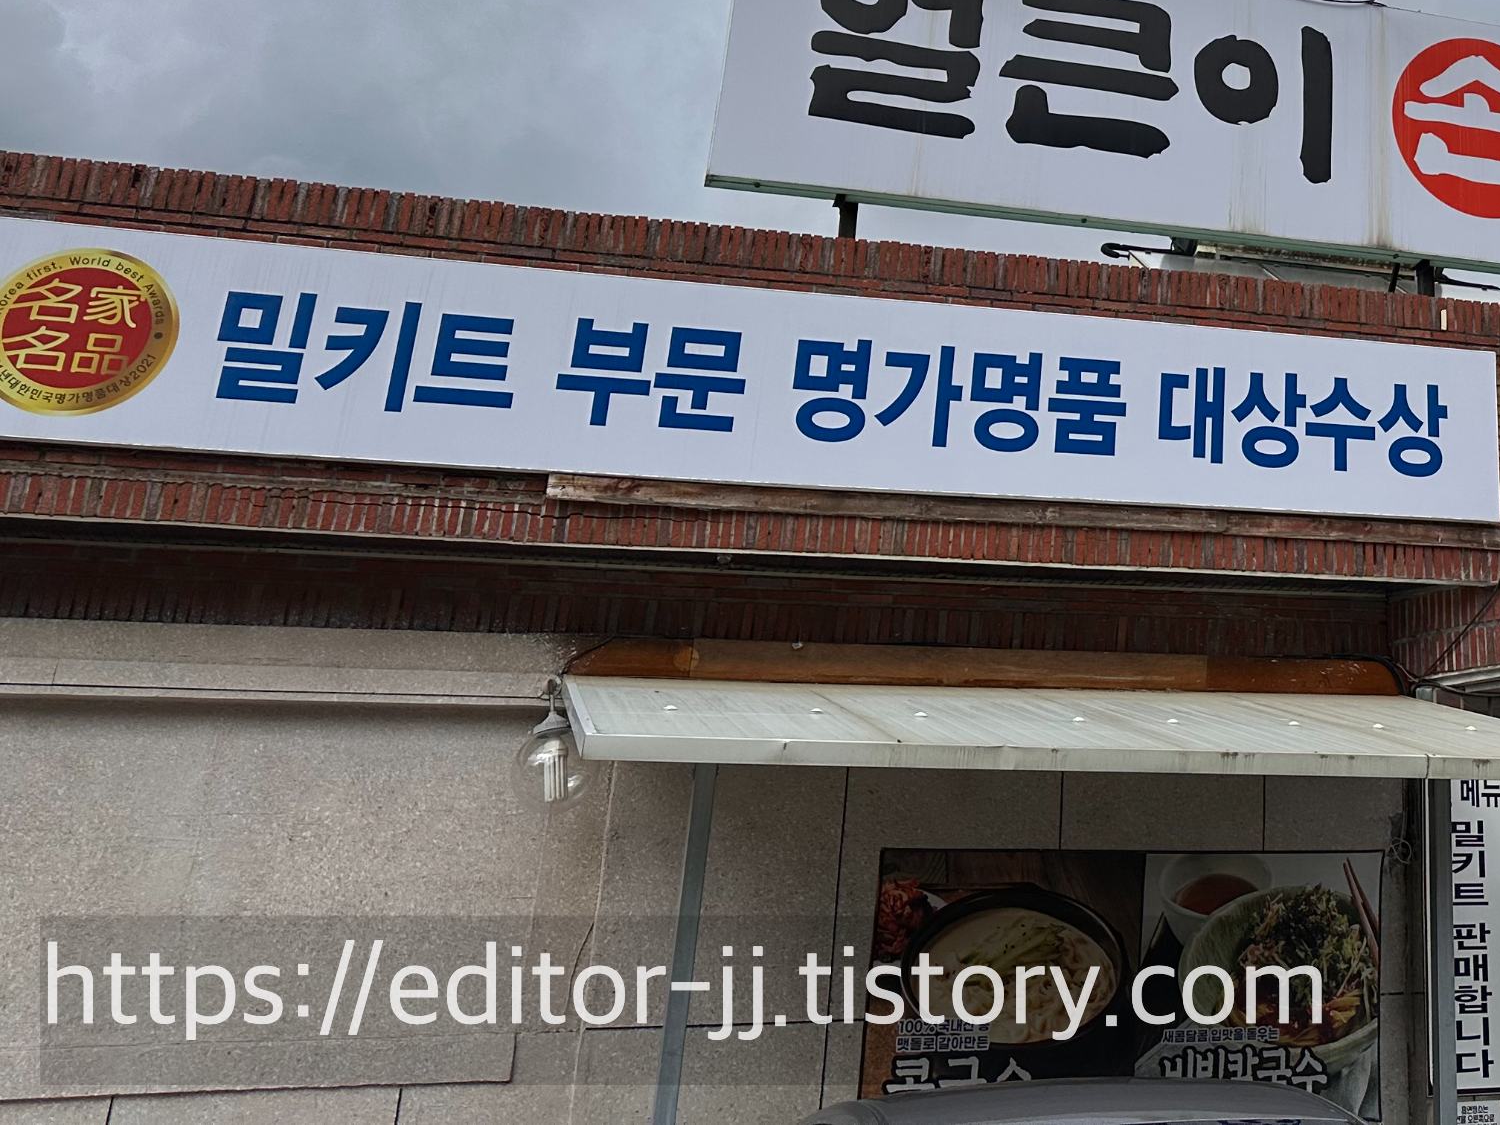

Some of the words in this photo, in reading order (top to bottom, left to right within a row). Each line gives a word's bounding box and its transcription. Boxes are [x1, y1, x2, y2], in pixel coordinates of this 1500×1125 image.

[10, 278, 146, 328] 名家
[69, 256, 112, 267] World
[115, 261, 145, 282] best
[143, 283, 166, 326] Awards
[2, 326, 130, 375] 名品
[214, 291, 514, 413] 밀키트
[554, 317, 746, 432] 부문
[792, 336, 1128, 456] 명가명품
[1156, 367, 1447, 478] 대상수상
[1451, 820, 1489, 906] 밀키트
[1453, 922, 1495, 1079] 판매합니다
[938, 1036, 989, 1051] 갈아만든
